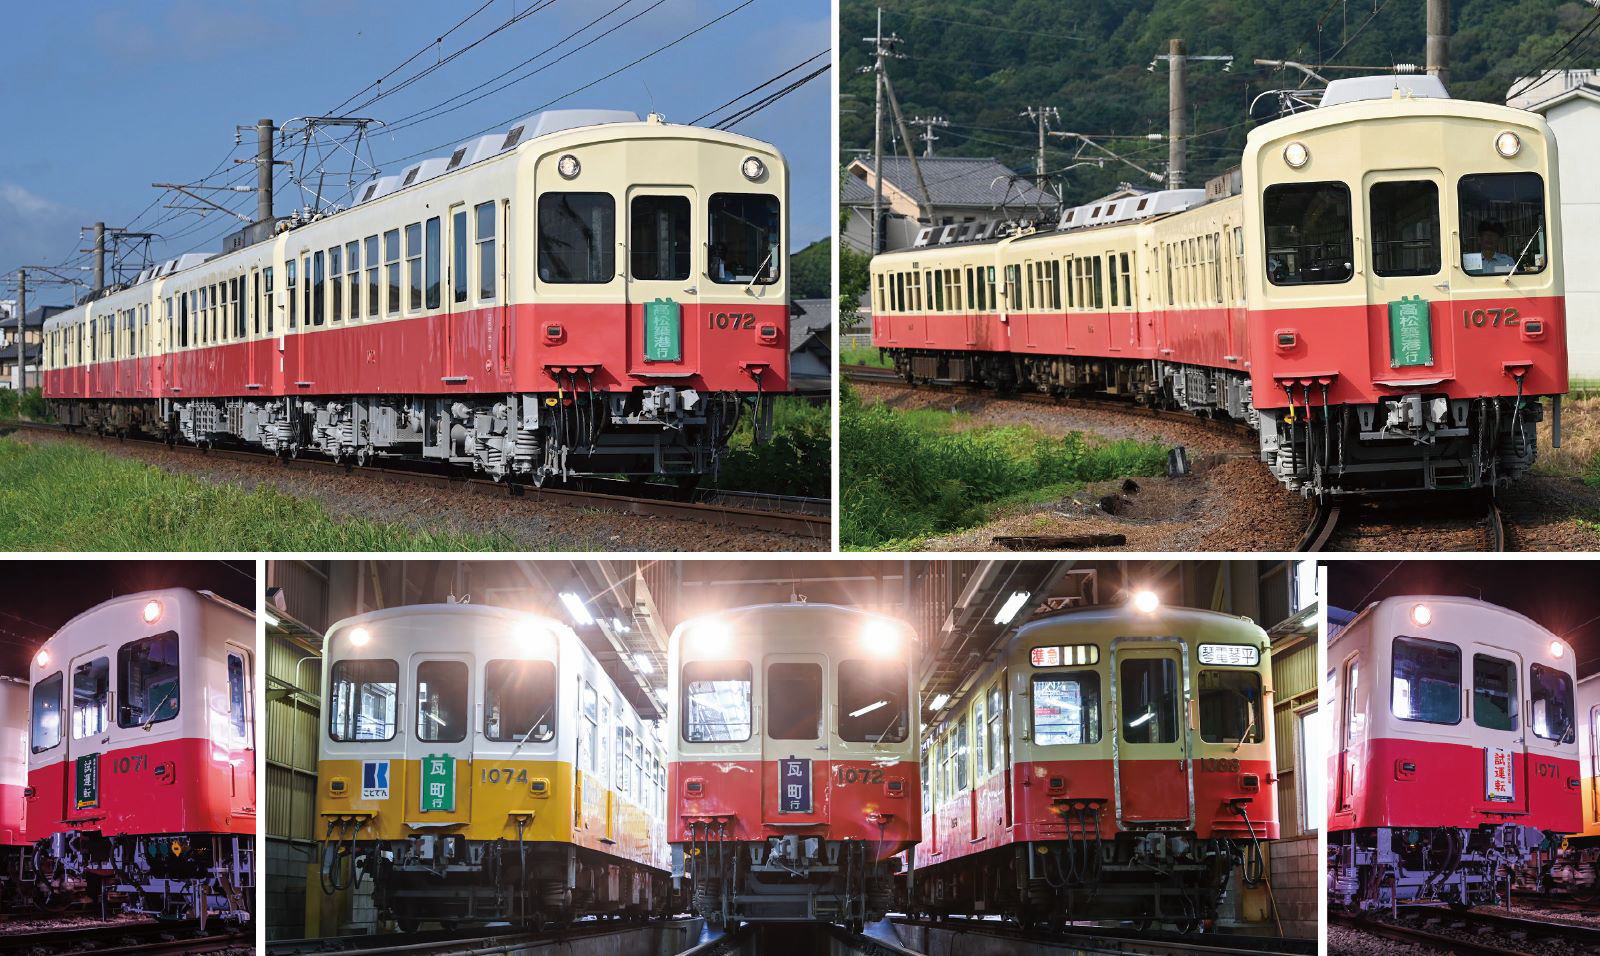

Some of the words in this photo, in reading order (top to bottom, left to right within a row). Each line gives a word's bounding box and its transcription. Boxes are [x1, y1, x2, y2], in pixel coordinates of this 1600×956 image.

[708, 312, 756, 330] 1072
[1463, 308, 1520, 328] 1072
[1032, 648, 1057, 665] 準急
[1202, 646, 1254, 664] 琴電琴平
[113, 754, 147, 774] 1071
[1494, 753, 1506, 792] 試運転
[1535, 762, 1560, 779] 1071
[430, 760, 446, 808] 瓦町行
[481, 768, 528, 784] 1074
[838, 768, 885, 784] 1072
[363, 789, 388, 797] ことでん
[787, 761, 803, 810] 瓦町行
